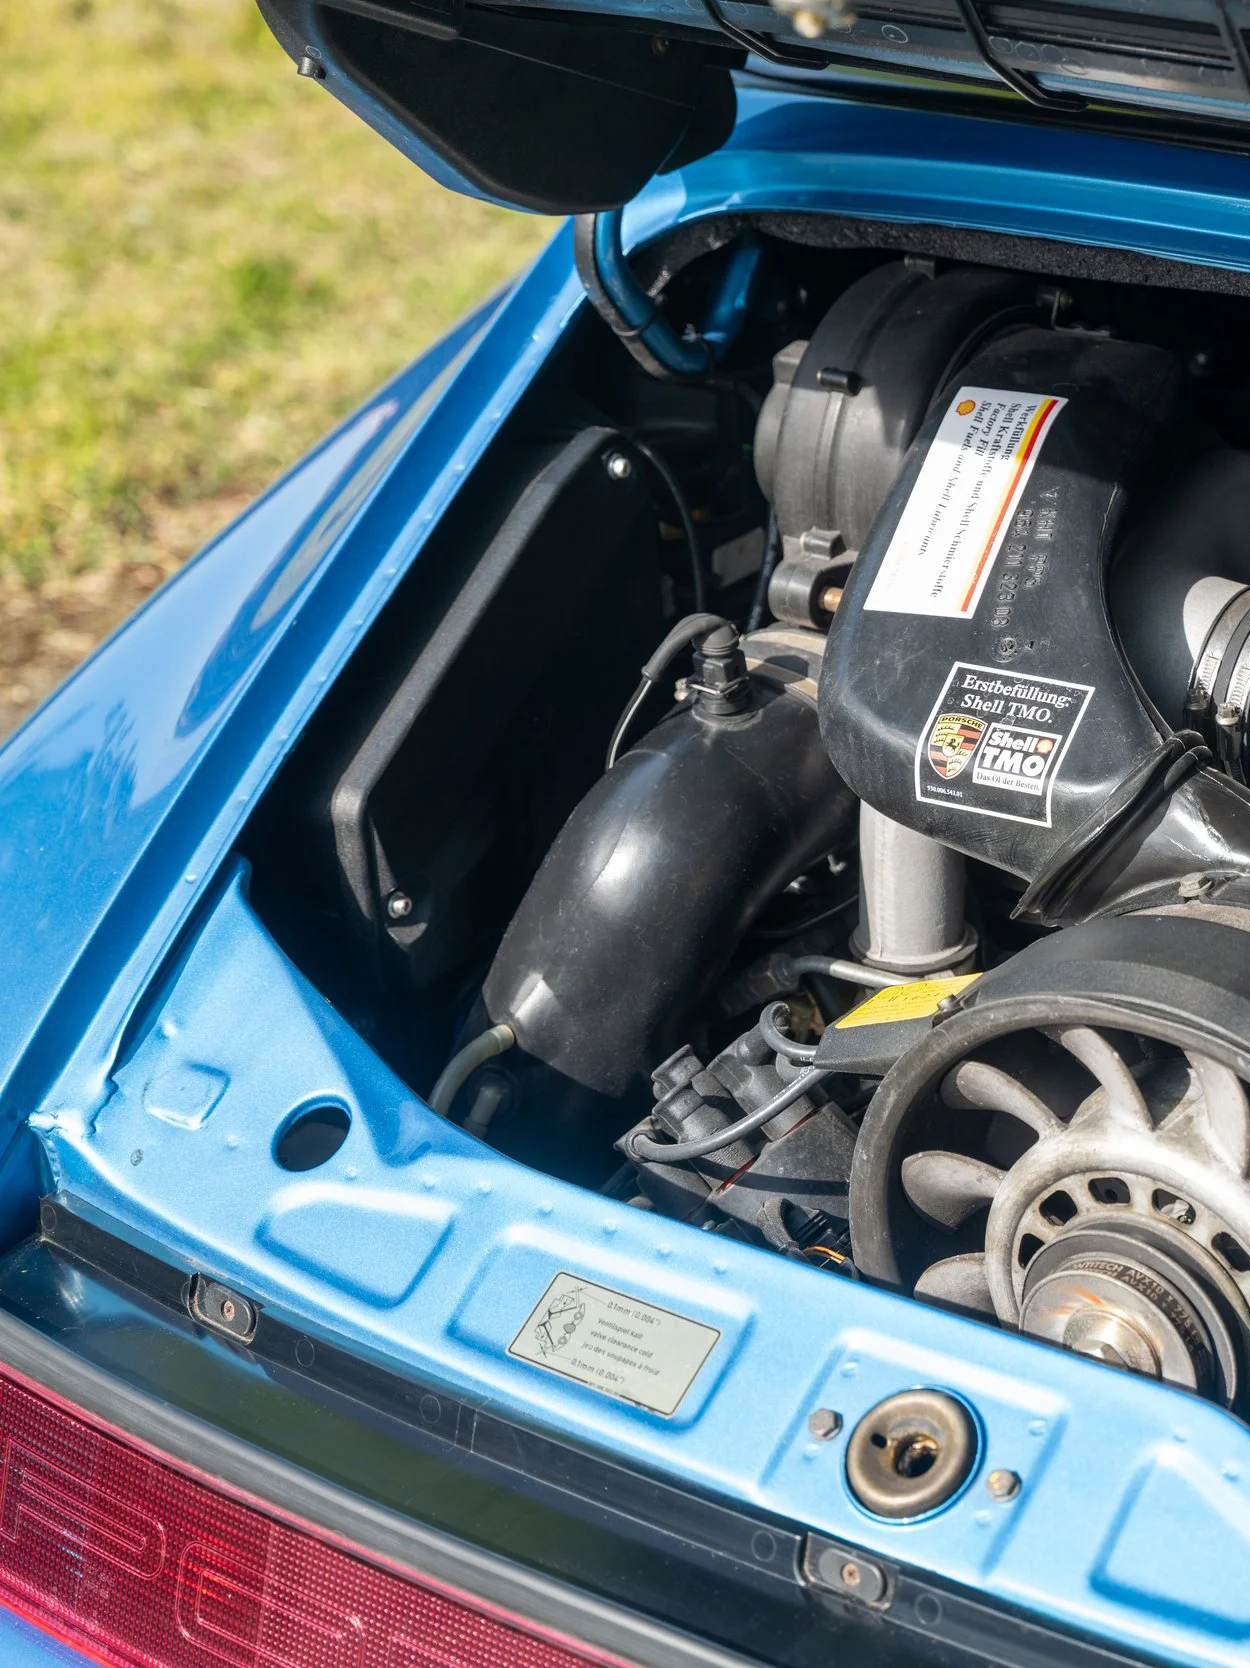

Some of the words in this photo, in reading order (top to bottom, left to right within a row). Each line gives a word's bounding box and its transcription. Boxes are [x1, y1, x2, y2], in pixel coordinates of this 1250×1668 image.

[973, 400, 992, 424] Shell
[981, 402, 1006, 435] Factory
[1001, 402, 1021, 424] Shell
[961, 424, 979, 451] Fuels
[1000, 404, 1037, 460] Werkfüllung
[975, 438, 989, 457] Fill
[980, 424, 1010, 477] Kraftstoffe
[953, 454, 964, 473] and
[941, 477, 958, 501] Shell
[971, 480, 984, 499] und
[960, 502, 977, 526] Shell
[918, 503, 946, 556] Lubricants
[930, 529, 966, 598] Schmierstoffe
[961, 674, 1072, 708] Erstbefüllung:
[961, 693, 1005, 714] Shell
[1005, 702, 1053, 723] TMO.
[941, 716, 983, 729] PORSCHE
[988, 730, 1039, 753] Shell
[983, 746, 1046, 777] TMO
[976, 771, 991, 781] Das
[1002, 776, 1014, 786] der
[1015, 777, 1040, 791] Besten.
[598, 1317, 630, 1335] Ventilspiel
[630, 1330, 643, 1340] kalt
[590, 1330, 607, 1341] valve
[607, 1335, 638, 1353] clearance
[638, 1348, 654, 1359] cold
[581, 1341, 594, 1351] jeu
[593, 1345, 606, 1356] des
[606, 1351, 637, 1368] soupapes
[643, 1364, 660, 1376] froid
